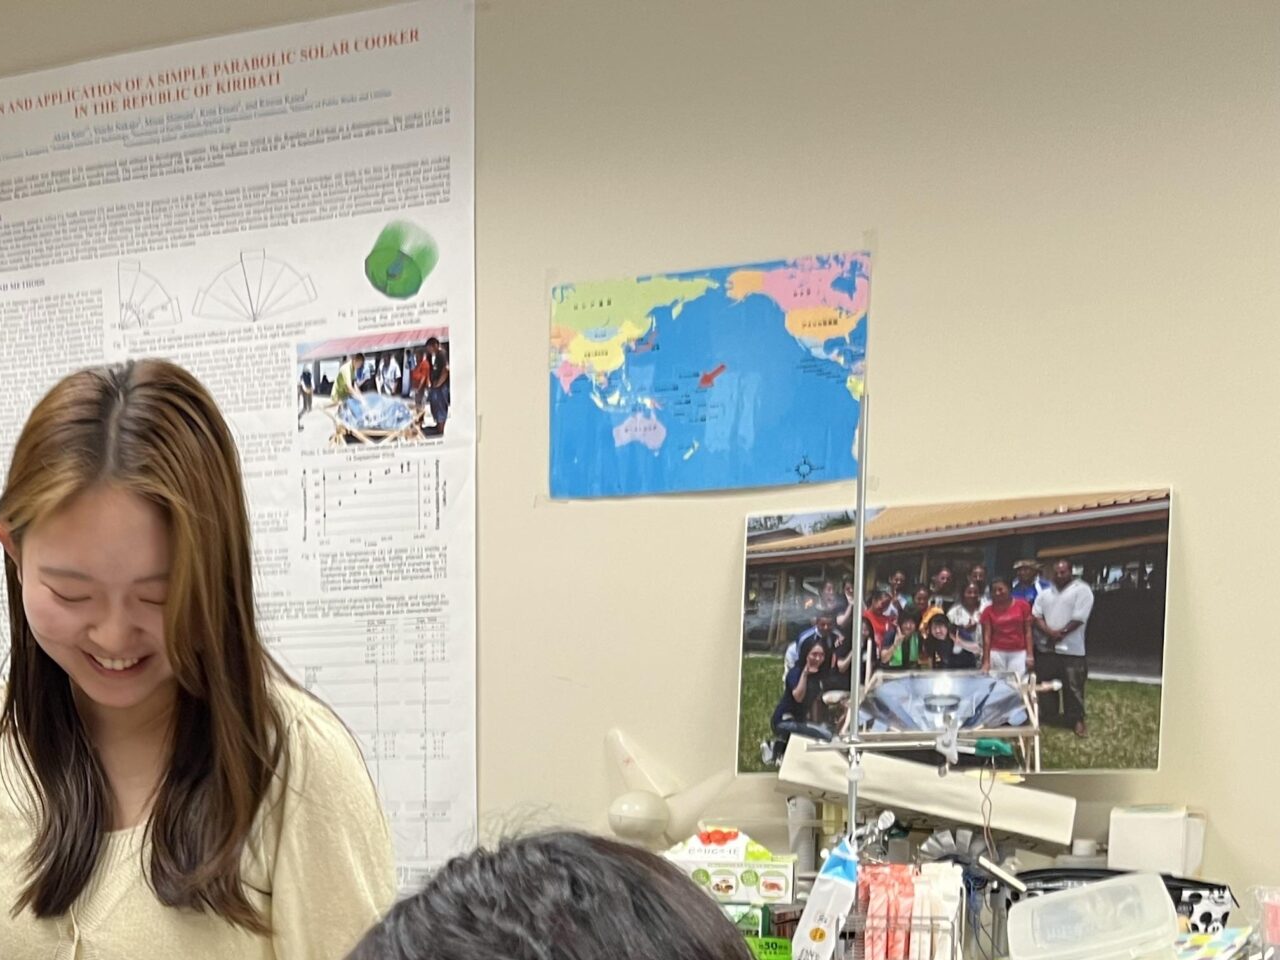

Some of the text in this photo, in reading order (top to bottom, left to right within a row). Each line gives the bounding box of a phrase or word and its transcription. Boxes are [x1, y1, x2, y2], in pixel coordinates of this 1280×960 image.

[8, 98, 33, 115] AND
[37, 83, 122, 110] APPLICATION
[125, 78, 145, 93] OF
[147, 74, 156, 88] A
[158, 64, 212, 86] SIMPLE
[213, 51, 296, 76] PARABOLIC
[300, 41, 350, 62] SOLAR
[354, 27, 420, 52] COOKER
[74, 72, 281, 119] IN THE REPUBLIC OF KIRIBATI
[10, 278, 46, 292] METHODS
